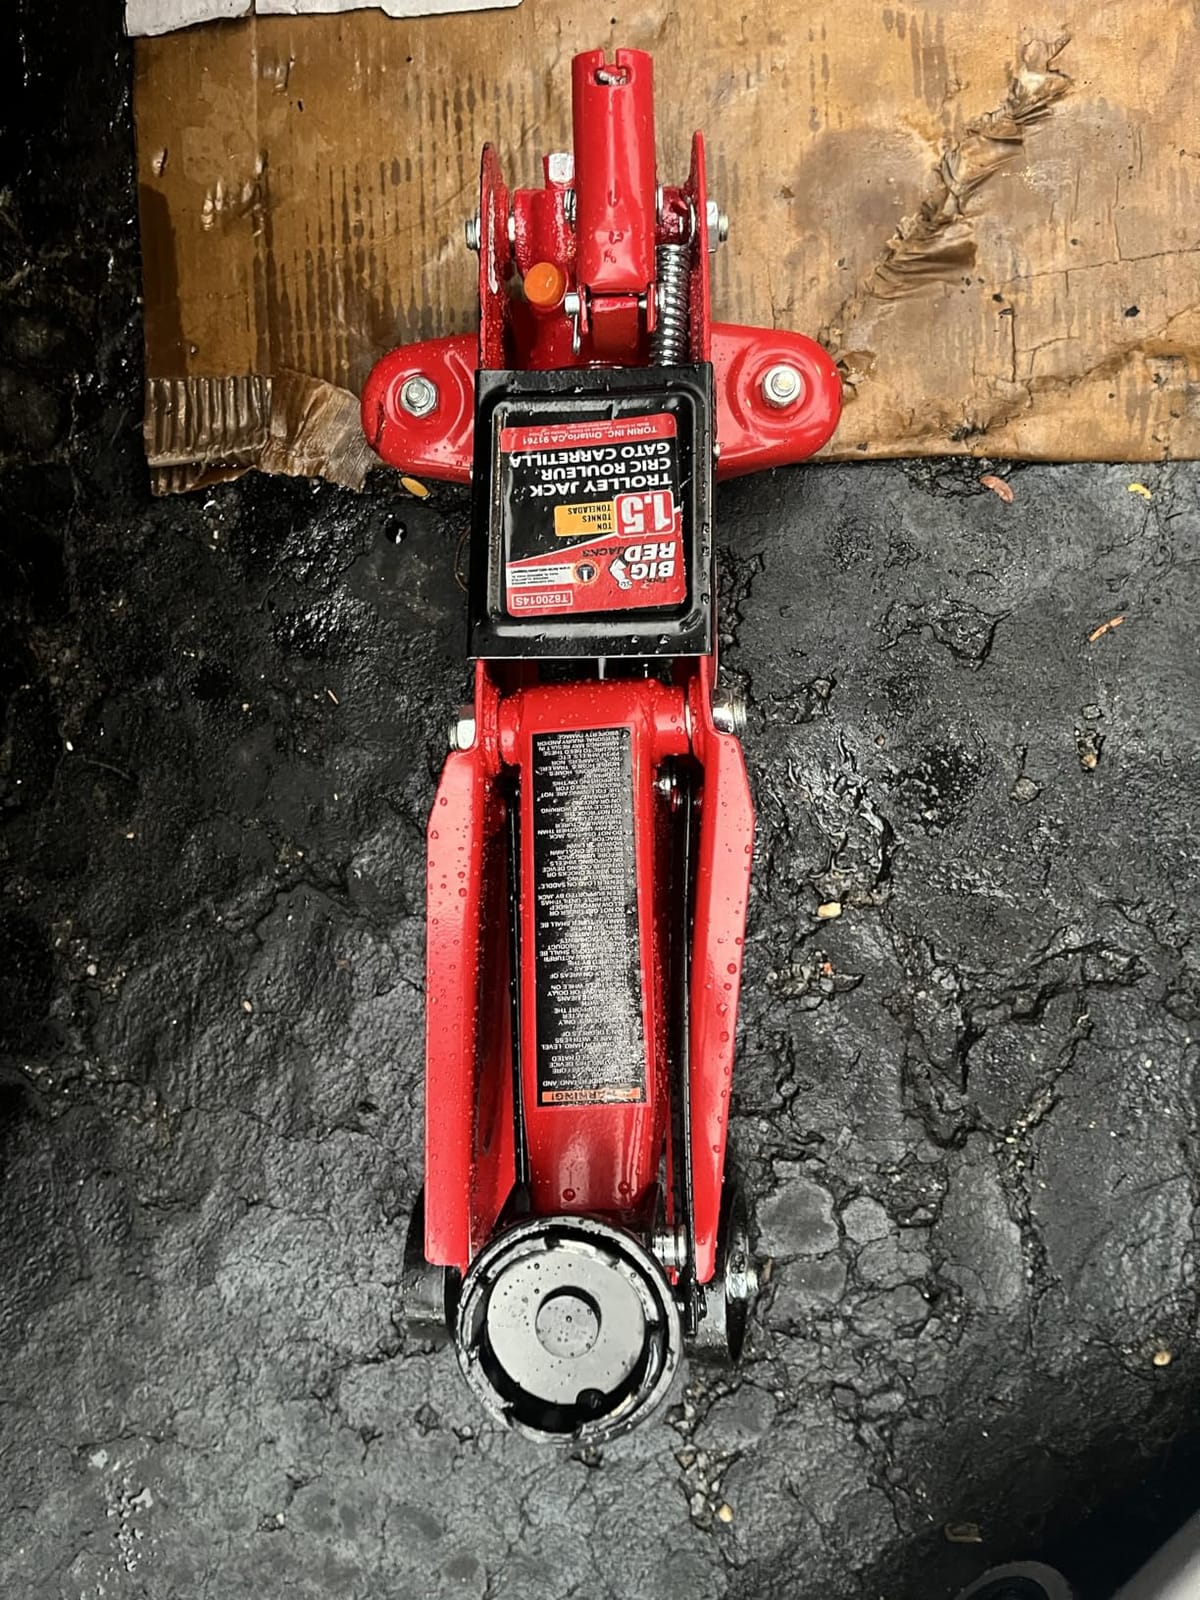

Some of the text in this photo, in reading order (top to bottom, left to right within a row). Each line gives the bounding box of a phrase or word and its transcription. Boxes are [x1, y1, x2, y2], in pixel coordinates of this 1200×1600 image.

[606, 429, 624, 437] INC.
[627, 426, 656, 435] TORIN
[522, 436, 549, 444] 91761
[509, 442, 670, 467] GATO CARRETILLA
[541, 457, 671, 480] CRIC ROULEUR
[530, 473, 672, 497] TROLLEY JACK
[567, 504, 610, 514] TONELADAS
[622, 493, 671, 533] 1.5
[582, 514, 611, 522] TONNES
[597, 522, 612, 530] TON
[582, 542, 675, 562] RED JACKS
[630, 561, 674, 580] BIG
